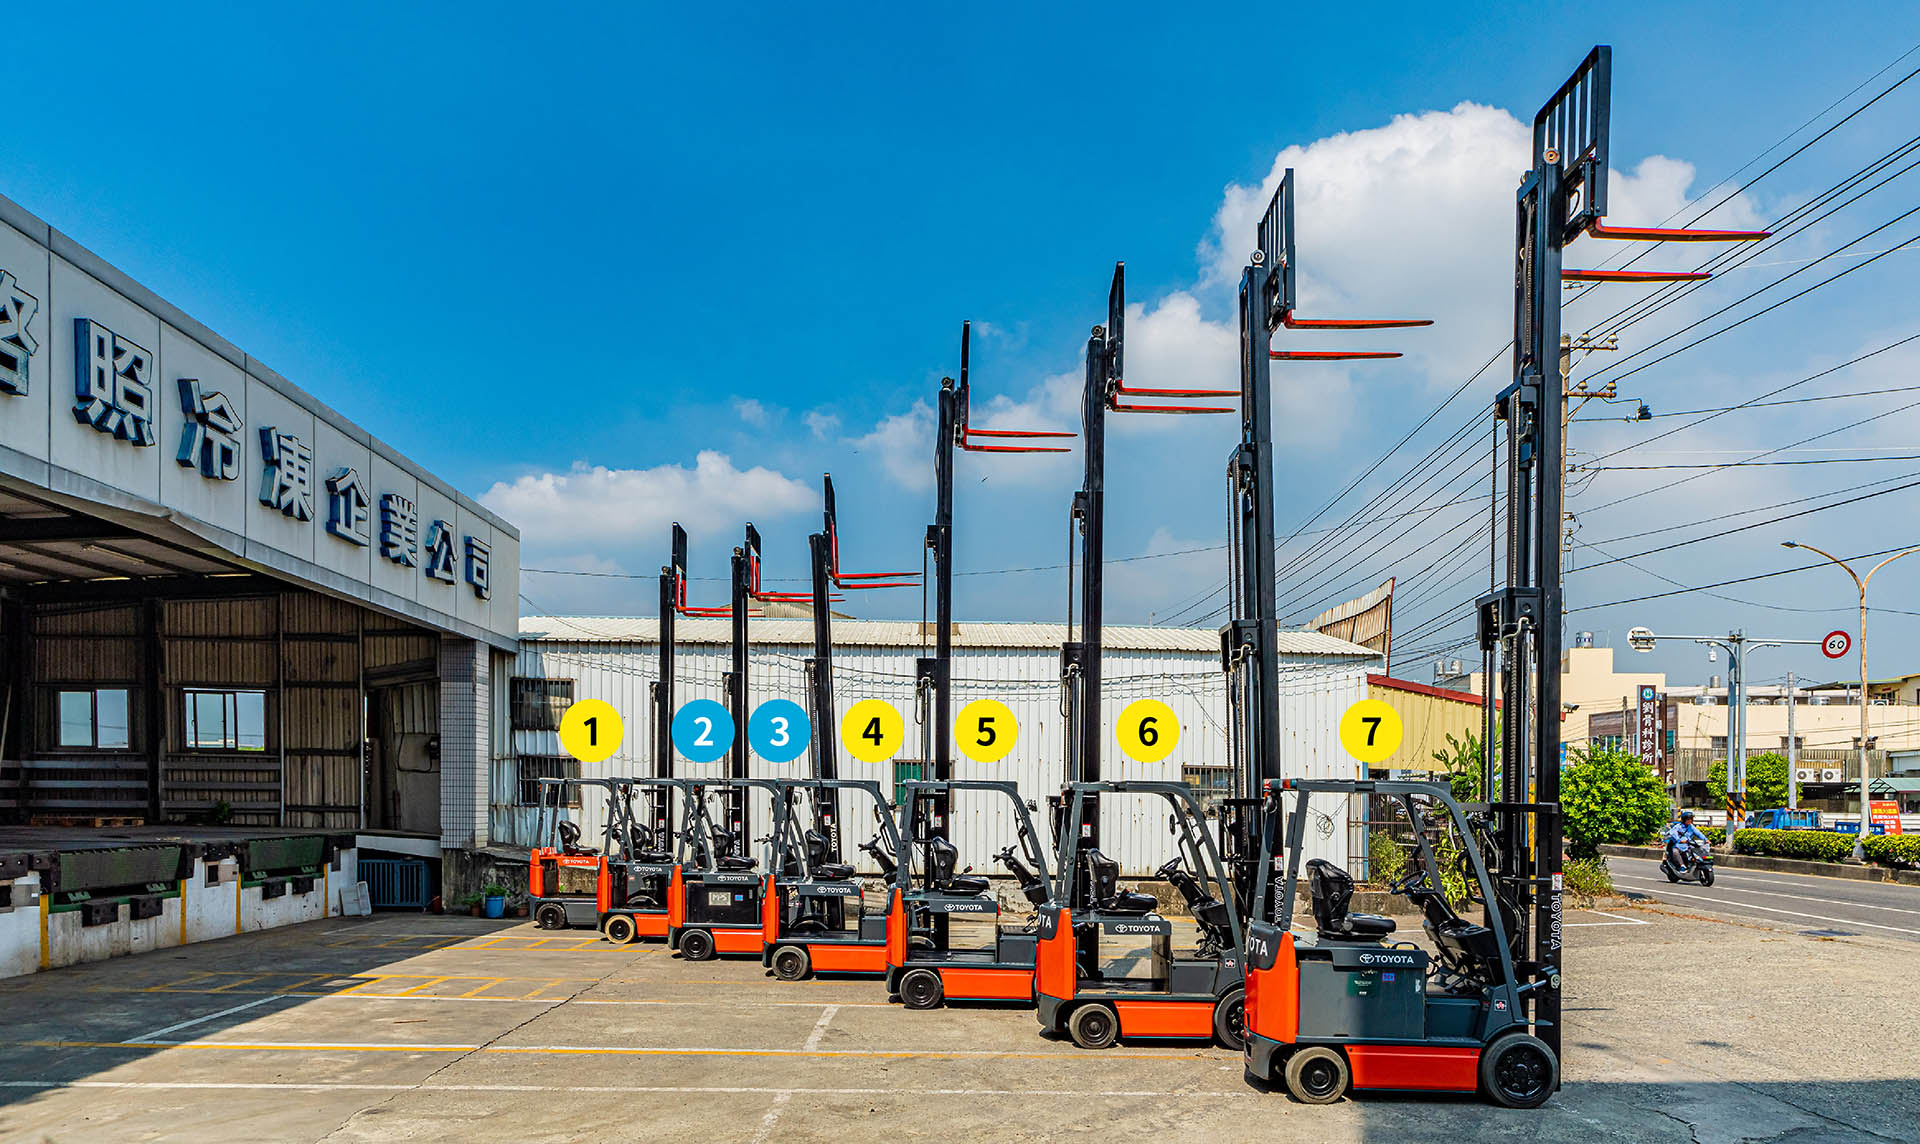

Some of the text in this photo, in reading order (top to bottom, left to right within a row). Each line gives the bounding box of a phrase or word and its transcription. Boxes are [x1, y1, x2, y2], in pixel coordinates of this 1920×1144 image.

[1828, 640, 1845, 649] 60
[1642, 702, 1654, 764] 劉骨科診所
[1274, 875, 1284, 923] TOYOTA
[1550, 892, 1562, 950] TOYOTA
[1374, 955, 1415, 964] TOYOTA
